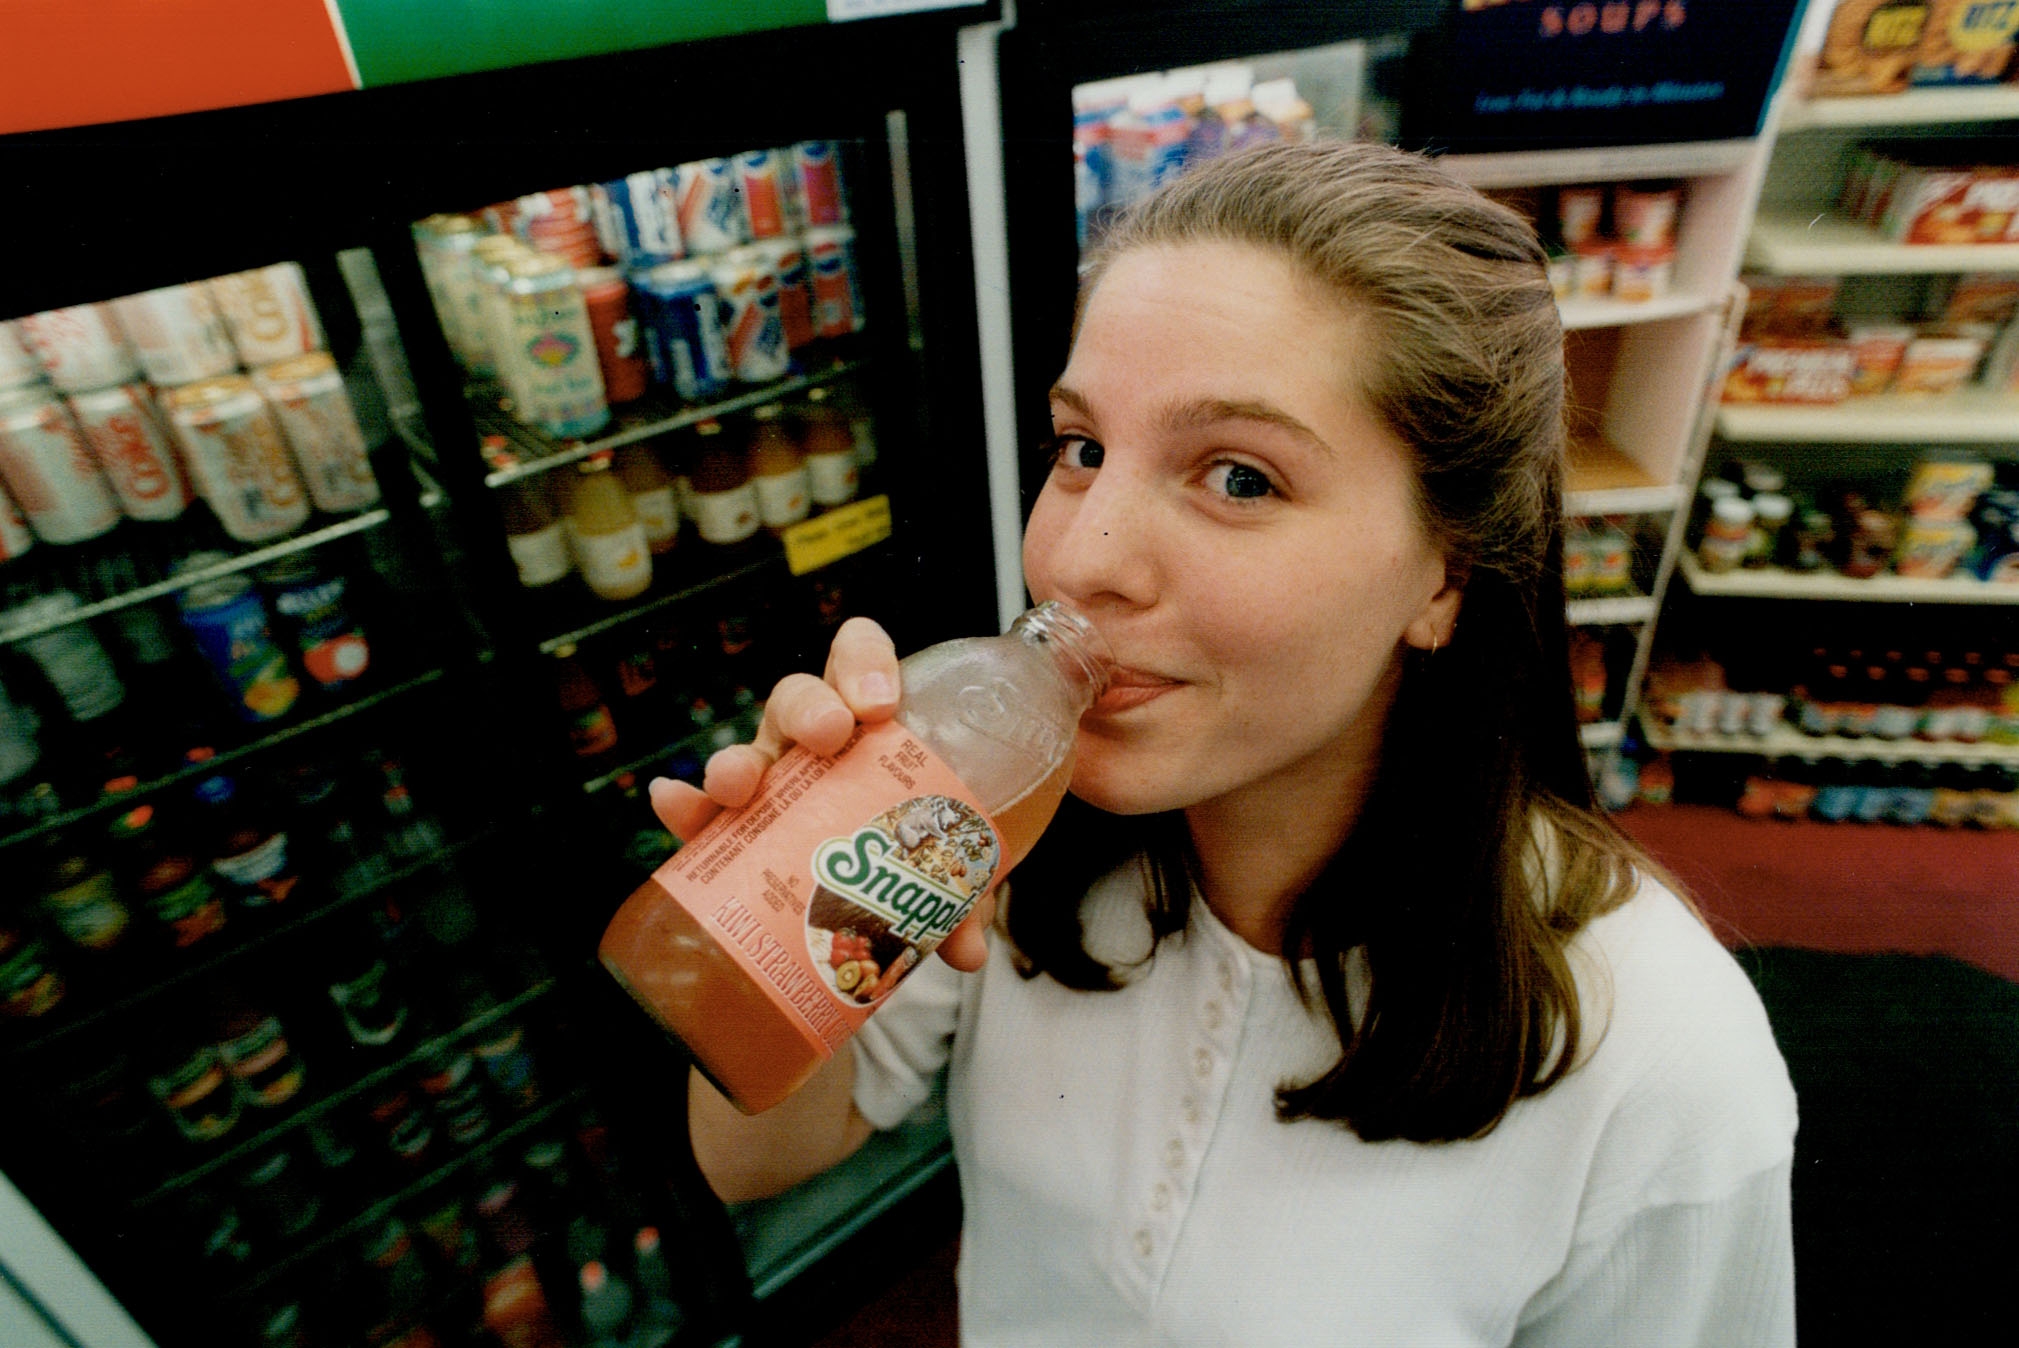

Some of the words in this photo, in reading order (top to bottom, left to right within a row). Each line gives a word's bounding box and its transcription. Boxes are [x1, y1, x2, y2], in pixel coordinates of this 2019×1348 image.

[1540, 0, 1687, 37] SOUPS
[878, 754, 916, 790] FLAVOURS
[895, 751, 918, 772] FRUIT
[901, 739, 928, 768] REAL
[686, 835, 735, 882] RETURNABLE
[731, 821, 751, 840] FOR
[746, 797, 778, 826] DEPOSIT
[699, 841, 747, 885] CONTENANT
[743, 808, 782, 844] CONSIGNE
[711, 895, 763, 947] KIWI
[745, 932, 842, 1032] STRAWBERRY
